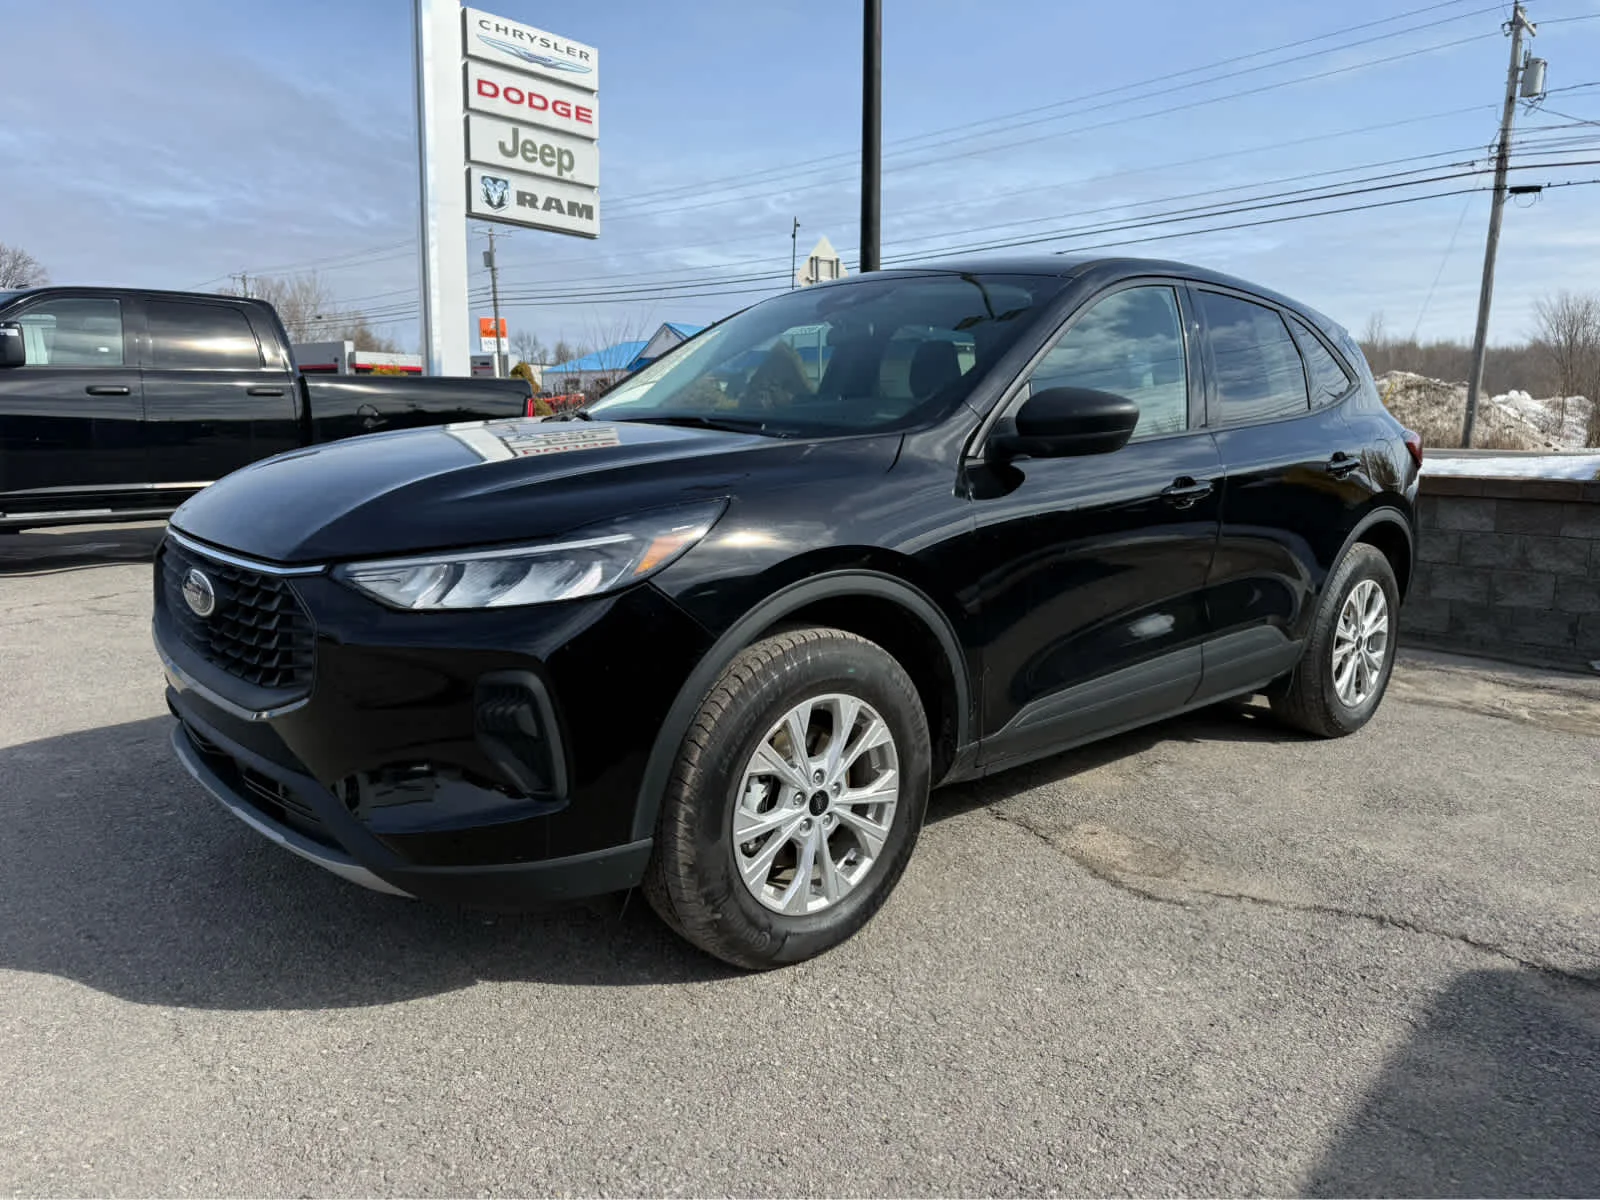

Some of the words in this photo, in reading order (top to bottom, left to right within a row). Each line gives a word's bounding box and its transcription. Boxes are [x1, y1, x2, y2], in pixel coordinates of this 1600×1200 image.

[478, 19, 590, 61] CHRYSLER
[477, 79, 593, 124] DODGE
[498, 127, 575, 176] Jeep
[516, 190, 594, 220] RAM
